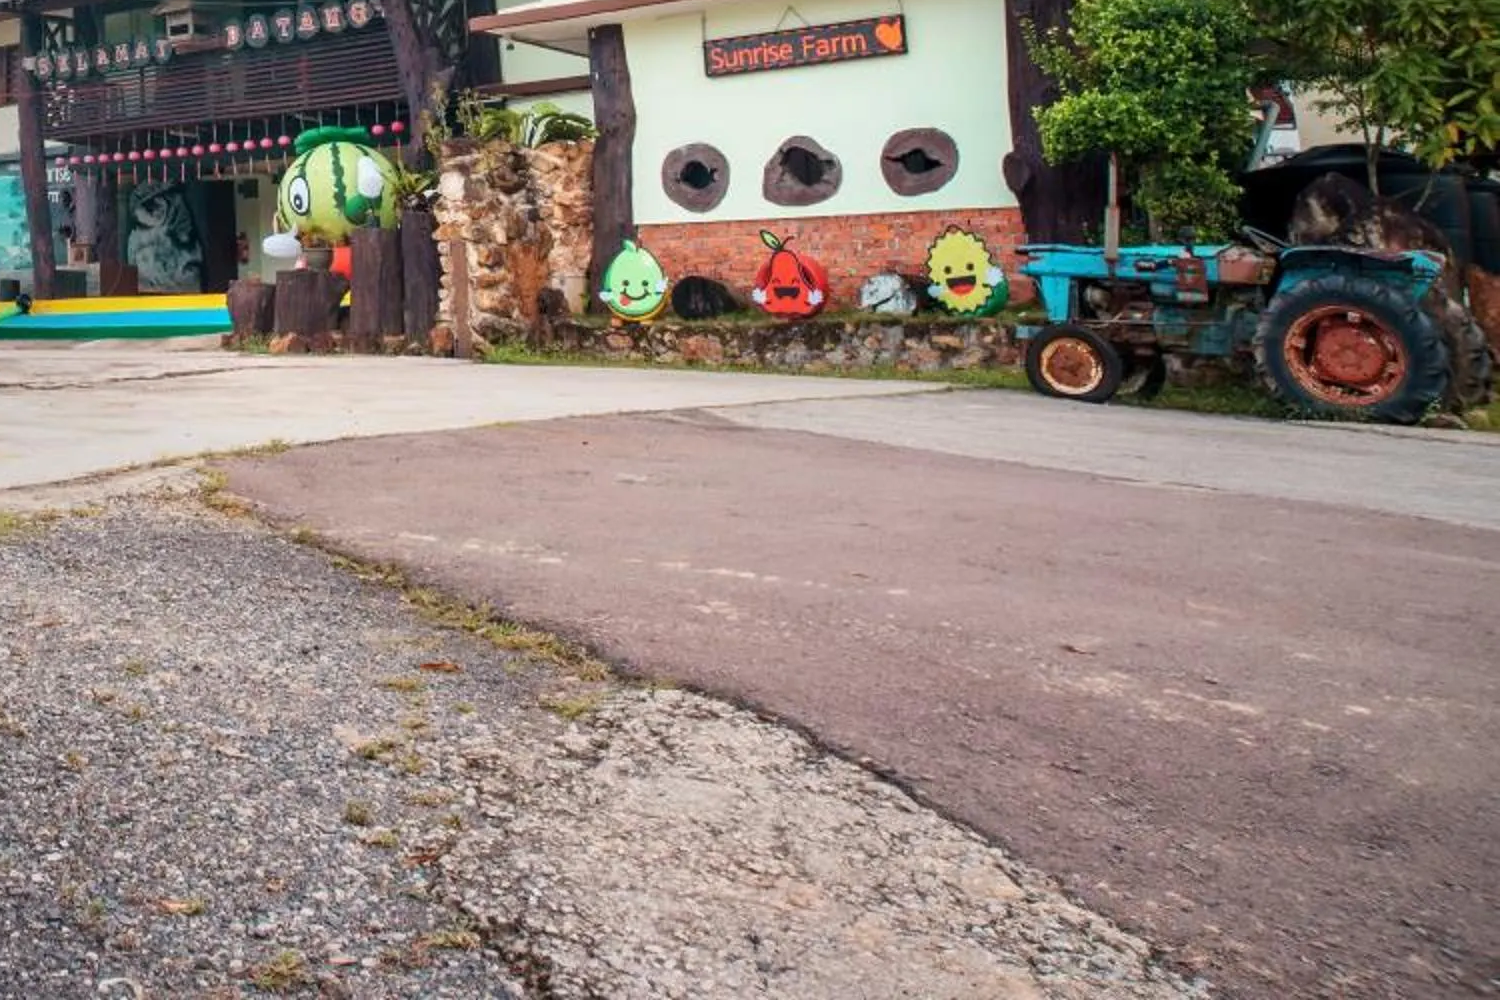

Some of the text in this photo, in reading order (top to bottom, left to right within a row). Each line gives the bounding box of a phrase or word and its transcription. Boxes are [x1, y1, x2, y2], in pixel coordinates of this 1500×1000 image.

[36, 38, 170, 76] SELAMAT
[710, 32, 867, 69] Sunrise Farm
